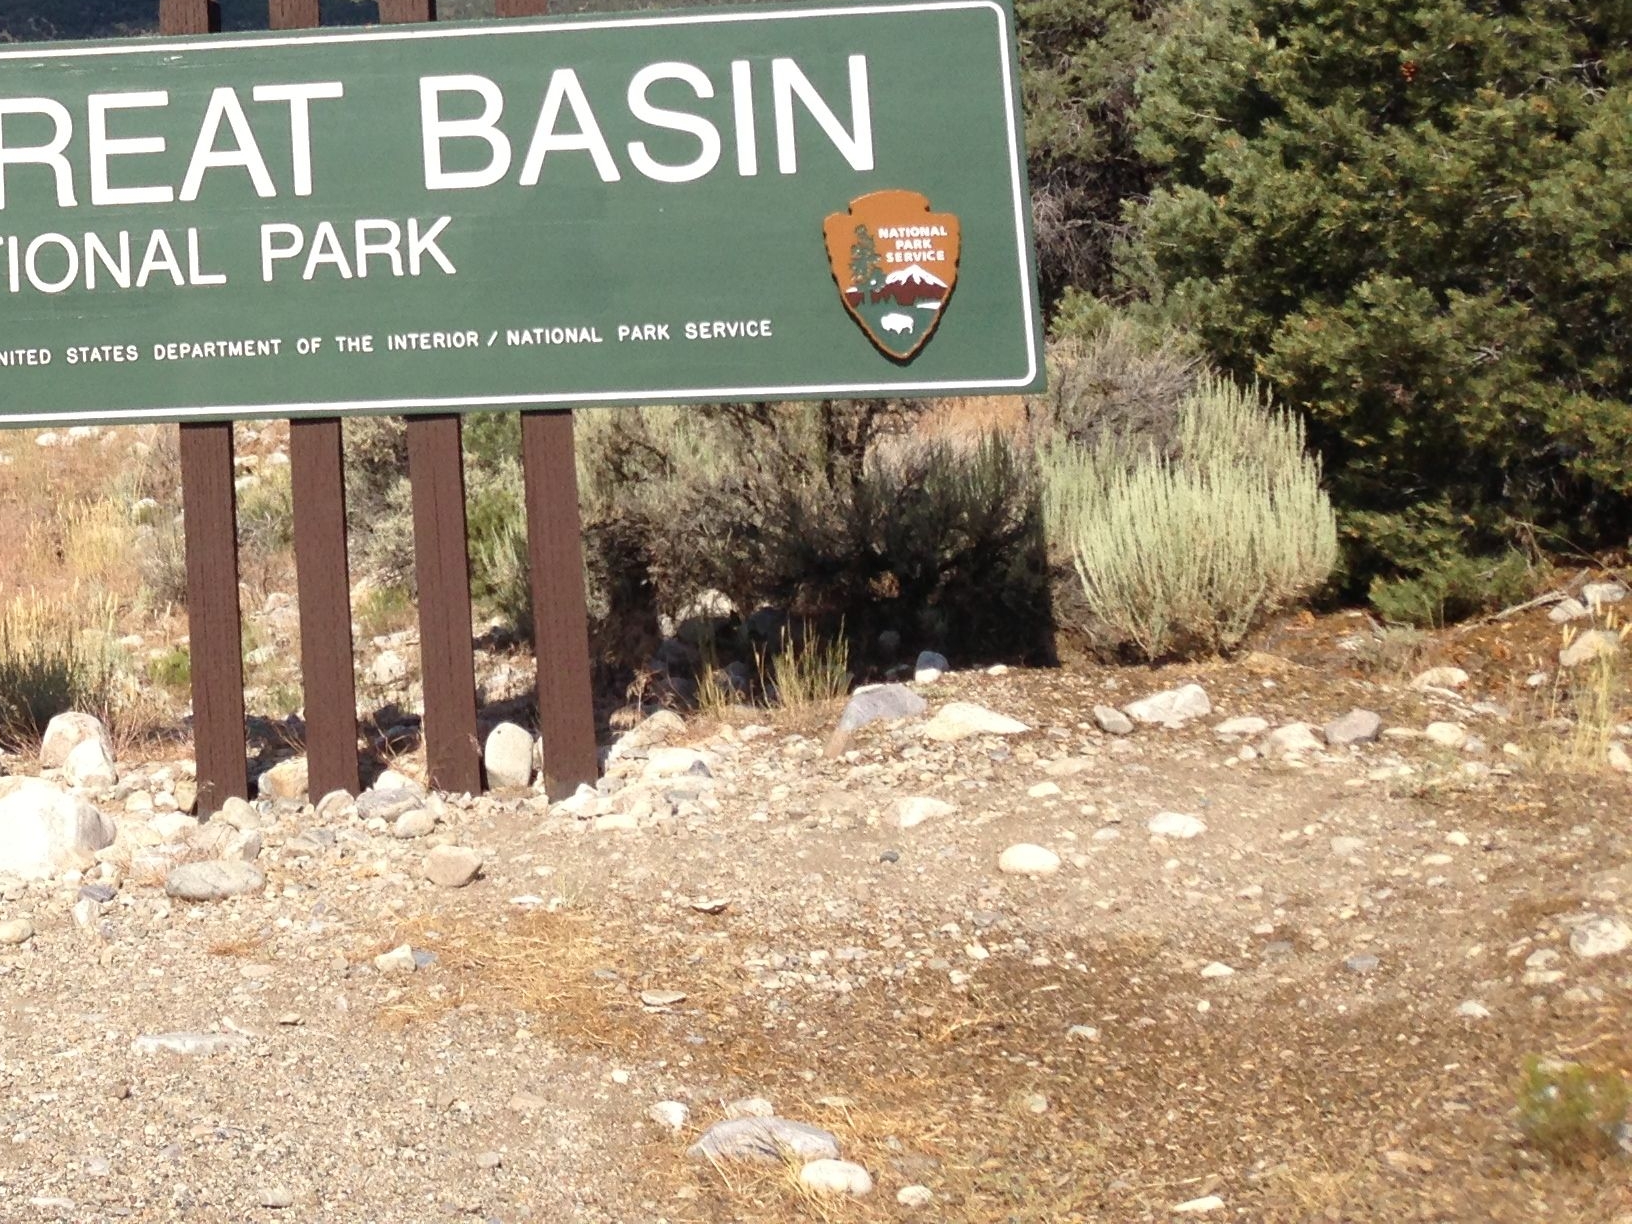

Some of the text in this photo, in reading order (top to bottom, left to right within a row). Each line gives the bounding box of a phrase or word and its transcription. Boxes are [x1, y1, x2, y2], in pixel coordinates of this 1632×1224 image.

[418, 54, 874, 190] BASIN
[878, 226, 948, 239] NATIONAL
[895, 239, 932, 250] PARK
[260, 215, 457, 282] PARK
[885, 251, 945, 263] SERVICE
[66, 344, 139, 364] STATES
[153, 338, 282, 361] DEPARTMENT
[296, 336, 322, 355] OF
[335, 334, 374, 353] THE
[387, 330, 479, 351] INTERIOR
[506, 326, 604, 346] NATIONAL
[617, 323, 671, 342] PARK
[684, 319, 773, 340] SERVICE
